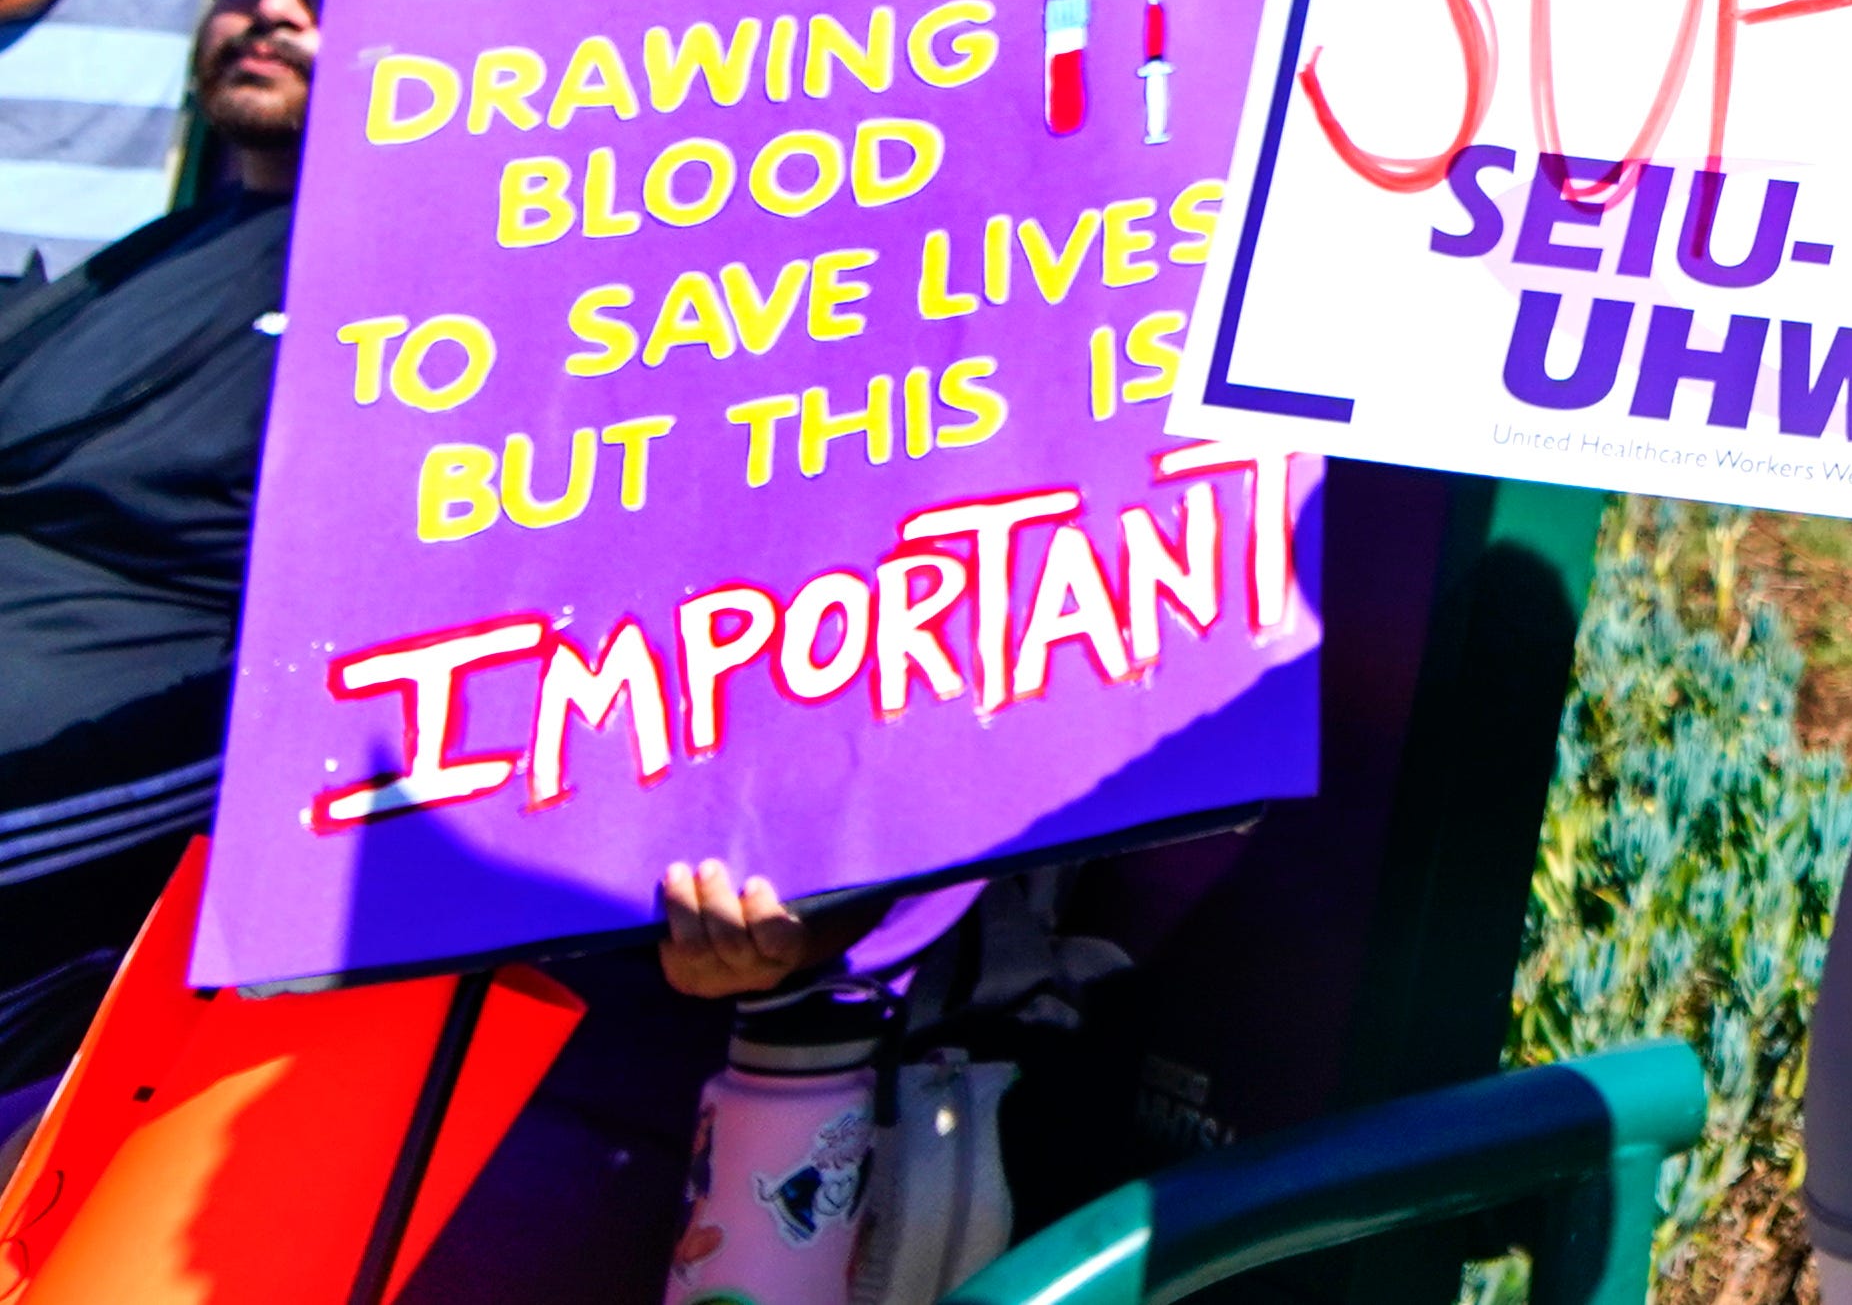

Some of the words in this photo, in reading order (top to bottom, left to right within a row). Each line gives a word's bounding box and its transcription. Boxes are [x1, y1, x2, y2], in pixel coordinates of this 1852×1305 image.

[495, 117, 945, 249] BLOOD
[1428, 144, 1835, 290] SEIU-
[336, 313, 497, 412] TO
[564, 248, 879, 378] SAVE
[917, 178, 1225, 321] LIVES
[416, 414, 676, 543] BUT
[727, 356, 1008, 488] THIS
[1089, 309, 1188, 421] IS
[1491, 423, 1571, 452] United
[1579, 432, 1708, 469] Healthcare
[1715, 448, 1815, 482] Workers
[311, 437, 1300, 837] IMPORTANT
